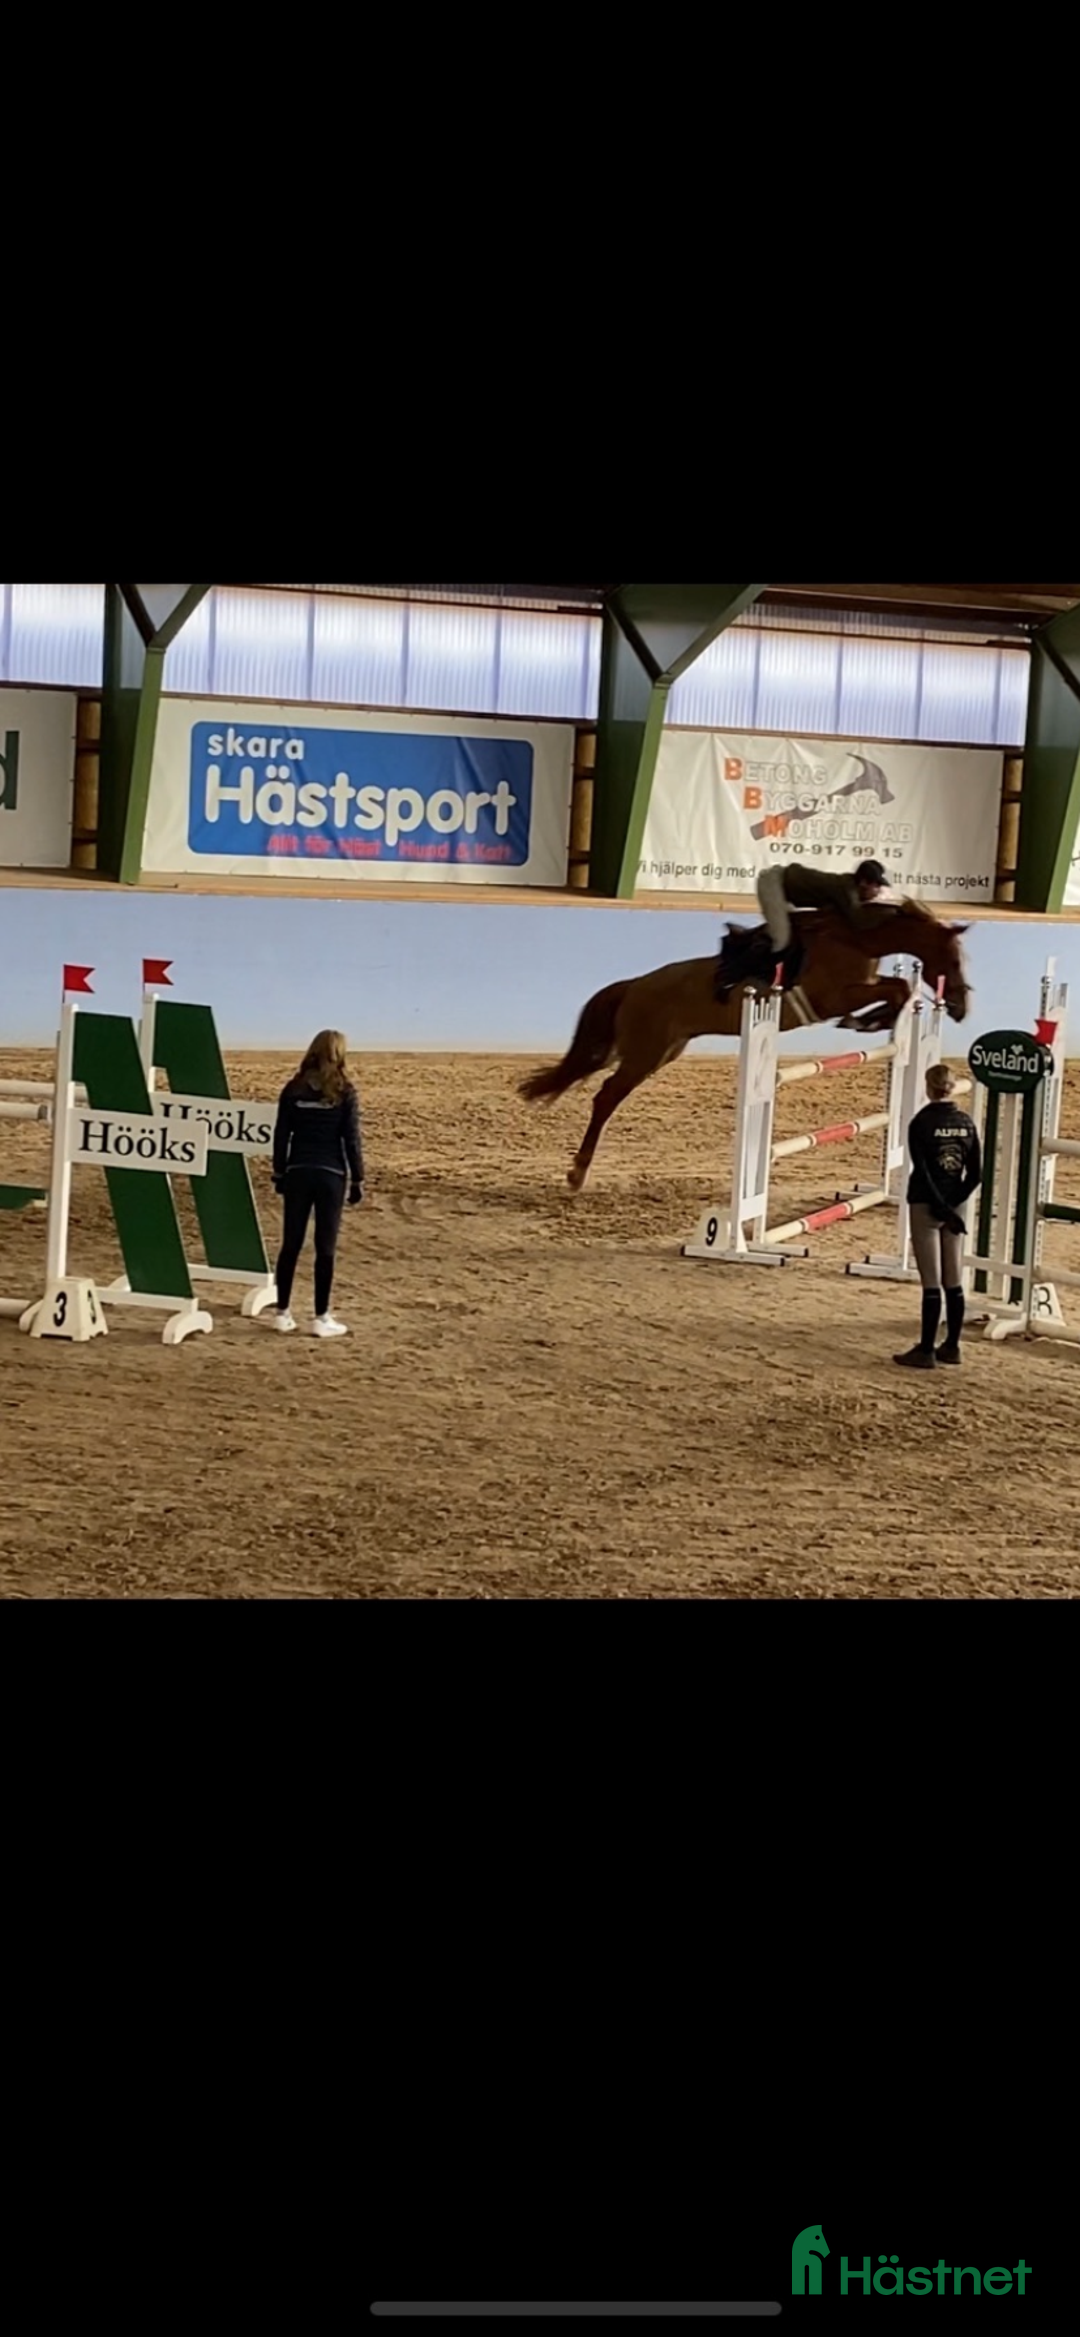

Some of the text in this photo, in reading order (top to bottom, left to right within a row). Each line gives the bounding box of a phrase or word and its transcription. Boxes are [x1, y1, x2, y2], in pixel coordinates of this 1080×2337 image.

[207, 728, 304, 760] skara
[724, 757, 828, 785] BETONG
[204, 764, 517, 846] Hästsport
[743, 786, 882, 816] BYGGARNA
[764, 814, 914, 844] MOHOLM AB
[769, 841, 903, 859] 070-917 99 15
[650, 861, 697, 878] hjälper
[701, 863, 722, 880] dig
[726, 866, 756, 879] med
[944, 874, 990, 891] projekt
[971, 1044, 1039, 1074] Sveland
[79, 1119, 196, 1164] Hööks
[705, 1216, 718, 1248] 9
[53, 1290, 67, 1328] 3
